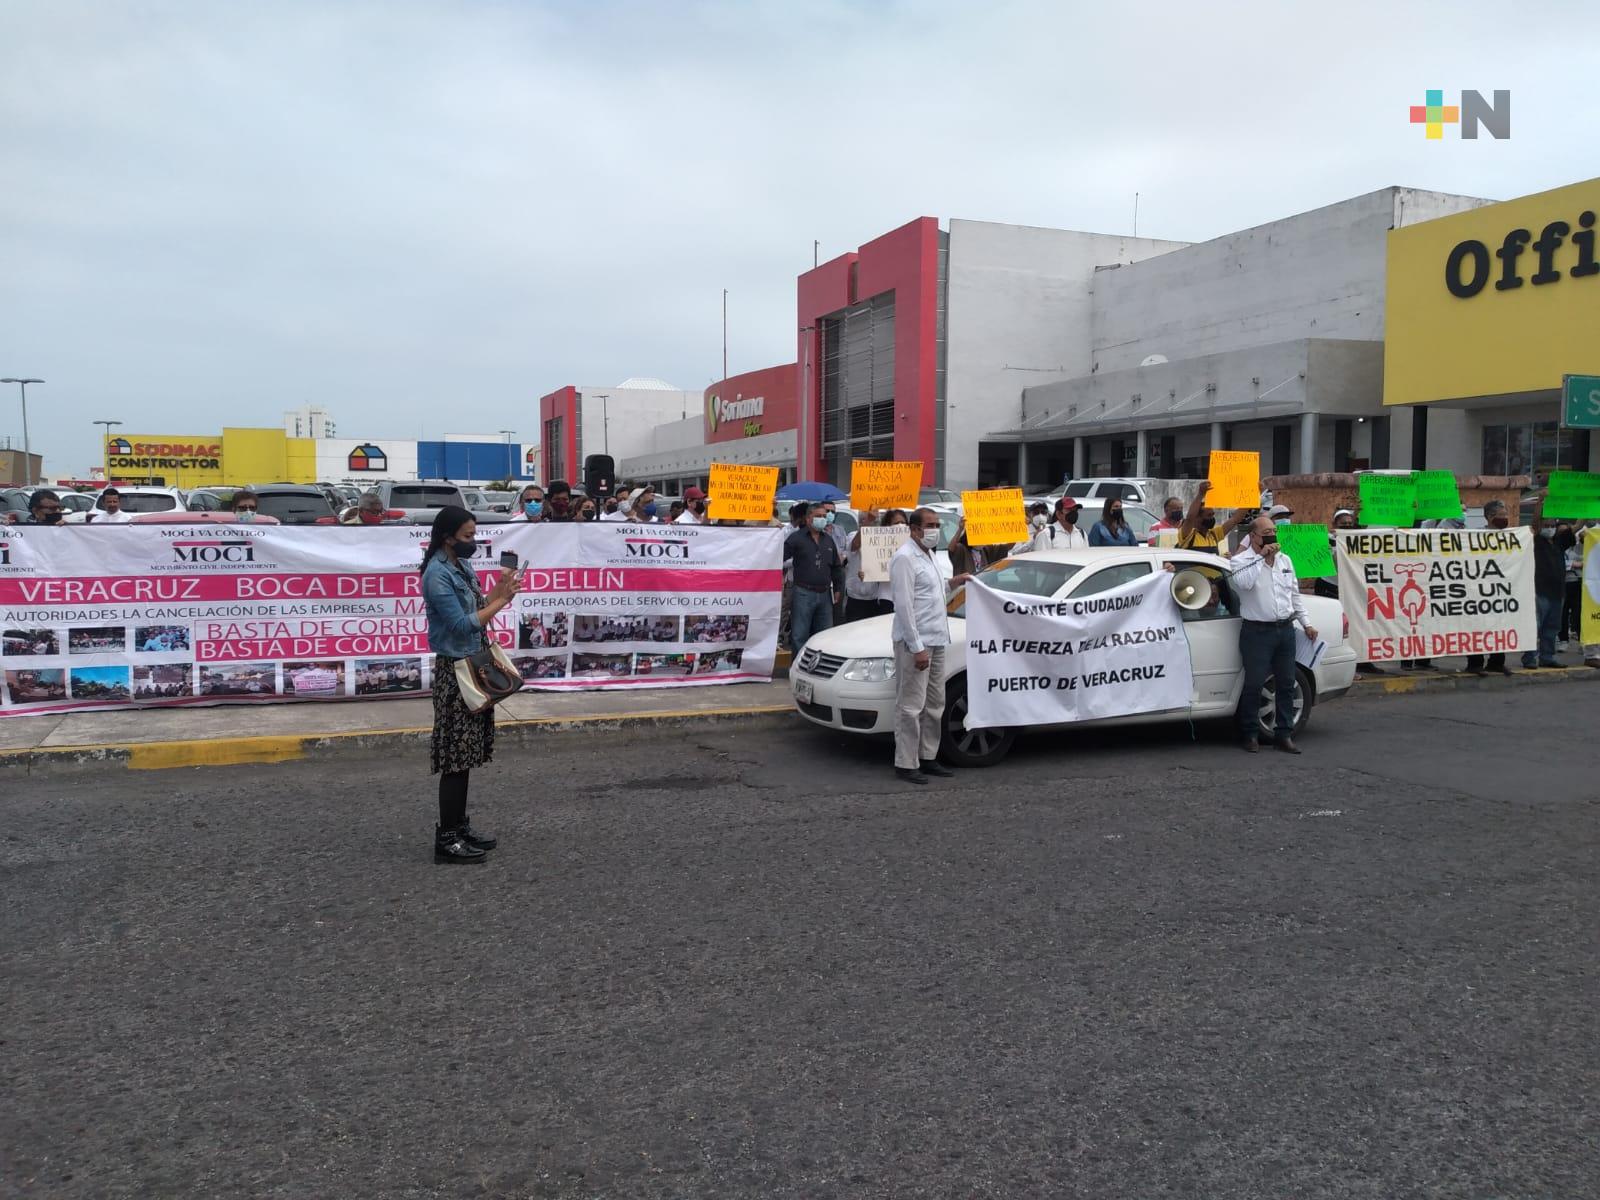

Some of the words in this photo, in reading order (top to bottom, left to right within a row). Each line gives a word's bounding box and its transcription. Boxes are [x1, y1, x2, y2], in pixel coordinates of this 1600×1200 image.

[1445, 211, 1600, 299] Offi
[721, 394, 764, 422] Soriana
[134, 443, 220, 457] SODIMAC
[109, 457, 219, 469] CONSTRUCTOR
[869, 470, 902, 483] BASTA
[728, 504, 736, 512] EN
[198, 529, 212, 537] VA
[215, 529, 266, 538] CONTIGO
[658, 529, 699, 537] CONTIGO
[1346, 532, 1432, 555] MEDELLIN
[1440, 532, 1462, 552] EN
[1469, 531, 1521, 552] LUCHA
[1364, 563, 1393, 584] EL
[1429, 559, 1505, 582] AGUA
[19, 578, 201, 602] VERACRUZ
[236, 577, 326, 598] BOCA
[337, 576, 394, 597] DEL
[1429, 583, 1467, 600] ES
[1479, 582, 1512, 600] UN
[5, 609, 118, 622] AUTORIDADES
[122, 608, 141, 620] LA
[145, 604, 253, 619] CANCELACIÓN
[258, 605, 276, 616] DE
[281, 605, 307, 616] LAS
[312, 603, 385, 615] EMPRESAS
[394, 599, 428, 615] MA
[522, 596, 607, 608] OPERADORAS
[611, 596, 634, 606] DEL
[637, 596, 689, 607] SERVICIO
[693, 597, 708, 606] DE
[711, 596, 744, 606] AGUA
[1073, 593, 1143, 616] CIUDADANO
[1430, 598, 1519, 618] NEGOCIO
[208, 621, 291, 640] BASTA
[300, 620, 333, 638] DE
[201, 639, 285, 659] BASTA
[294, 638, 328, 656] DE
[1002, 640, 1073, 656] FUERZA
[1078, 640, 1093, 654] DE
[1093, 638, 1108, 651] LA
[1368, 637, 1394, 661] ES
[1400, 634, 1426, 658] UN
[1432, 629, 1518, 657] DERECHO
[988, 676, 1051, 693] PUERTO
[1056, 676, 1078, 691] DE
[1082, 664, 1166, 688] VERACRUZ
